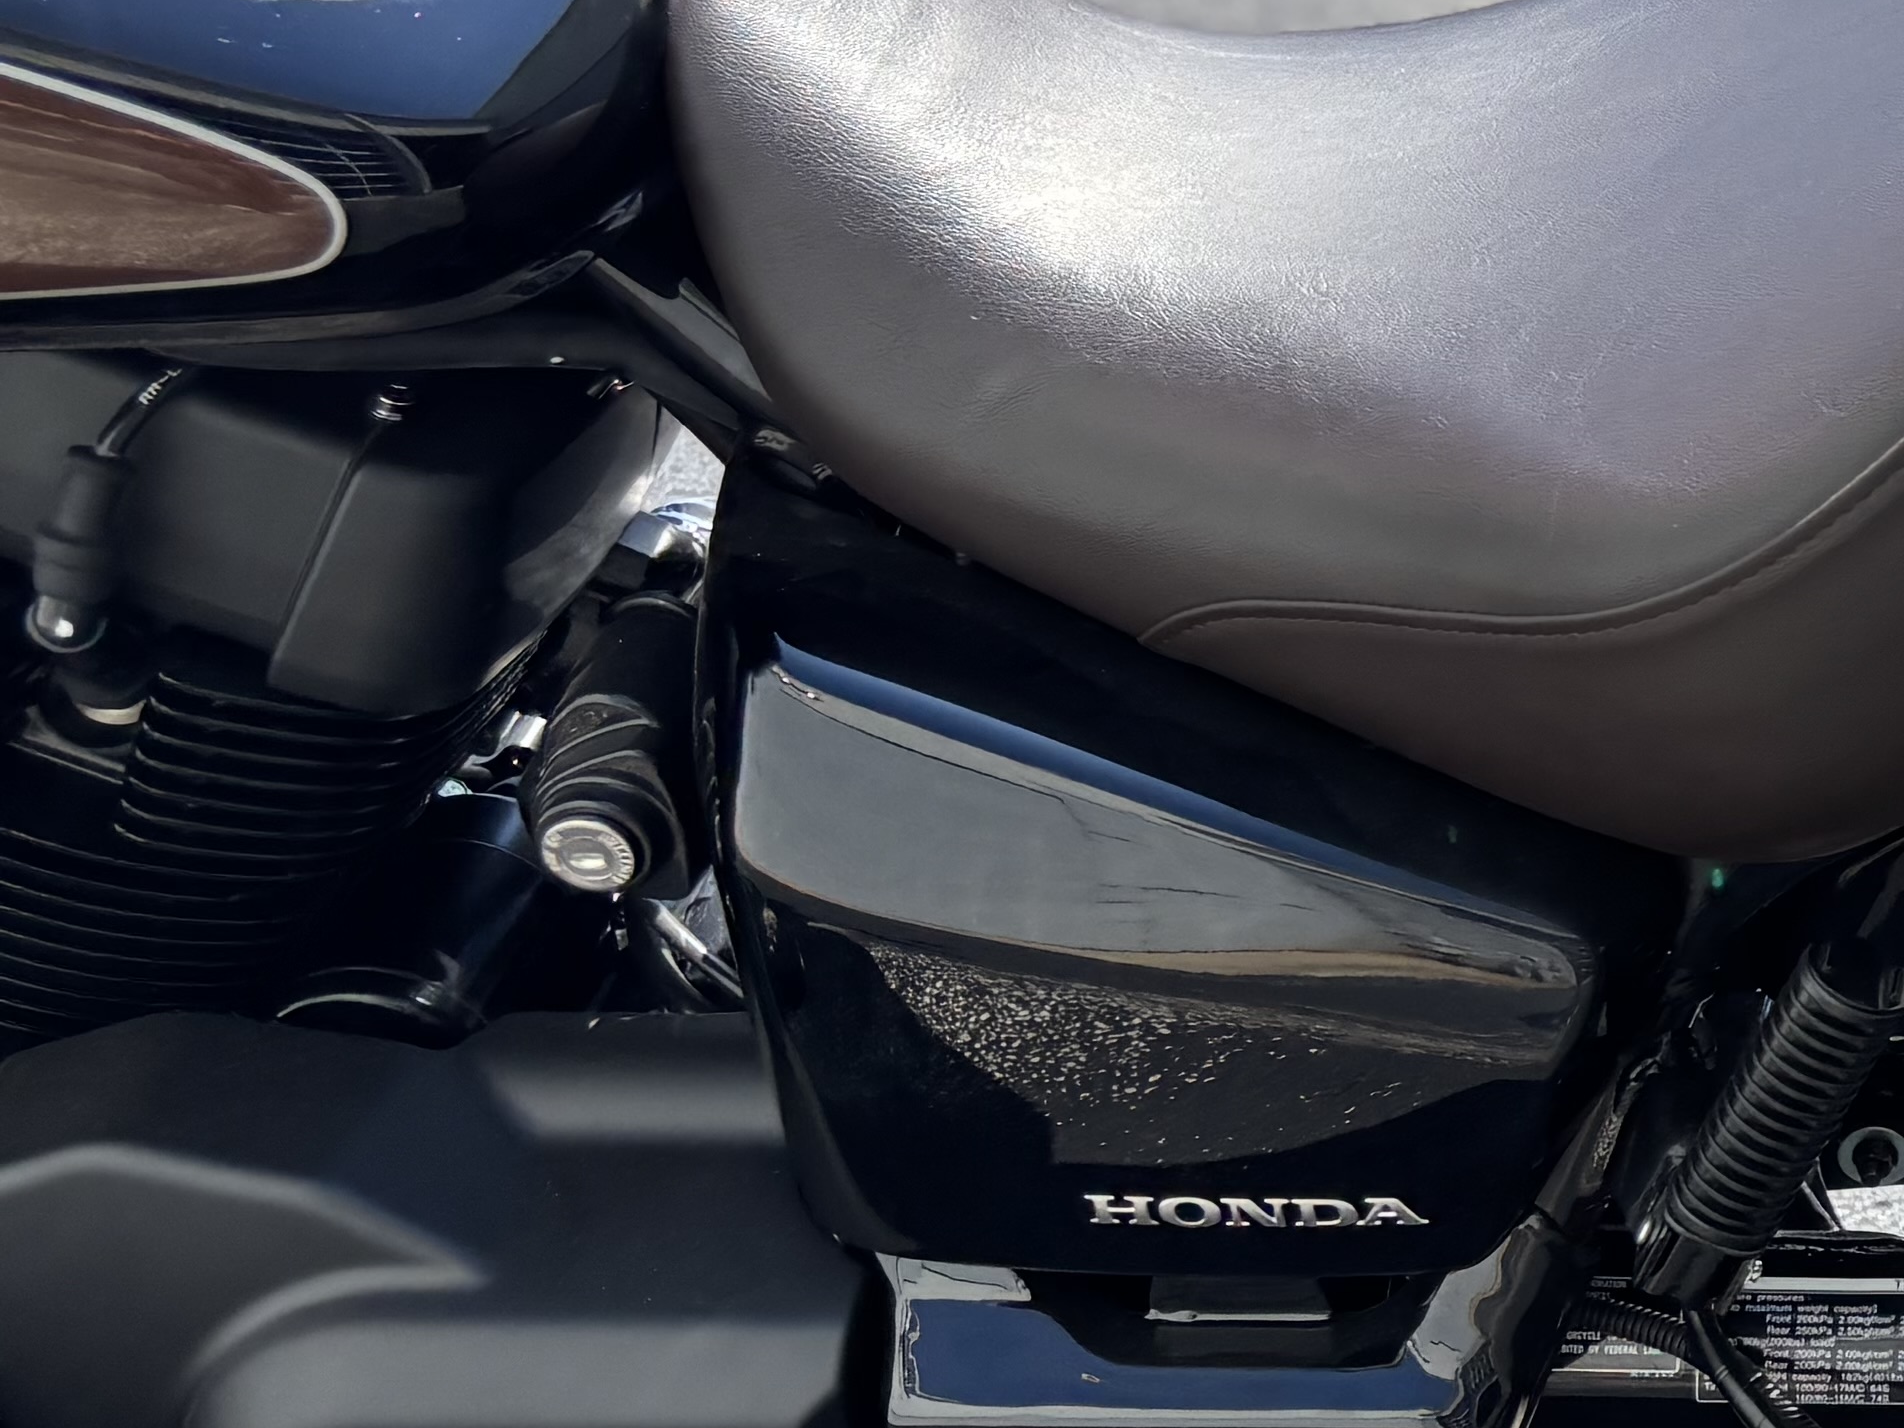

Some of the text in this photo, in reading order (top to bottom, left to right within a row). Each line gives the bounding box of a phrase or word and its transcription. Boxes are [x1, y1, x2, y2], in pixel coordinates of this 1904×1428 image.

[1083, 1194, 1430, 1228] HONDA
[1765, 1313, 1792, 1323] Front
[1604, 1345, 1638, 1355] FEDERAL
